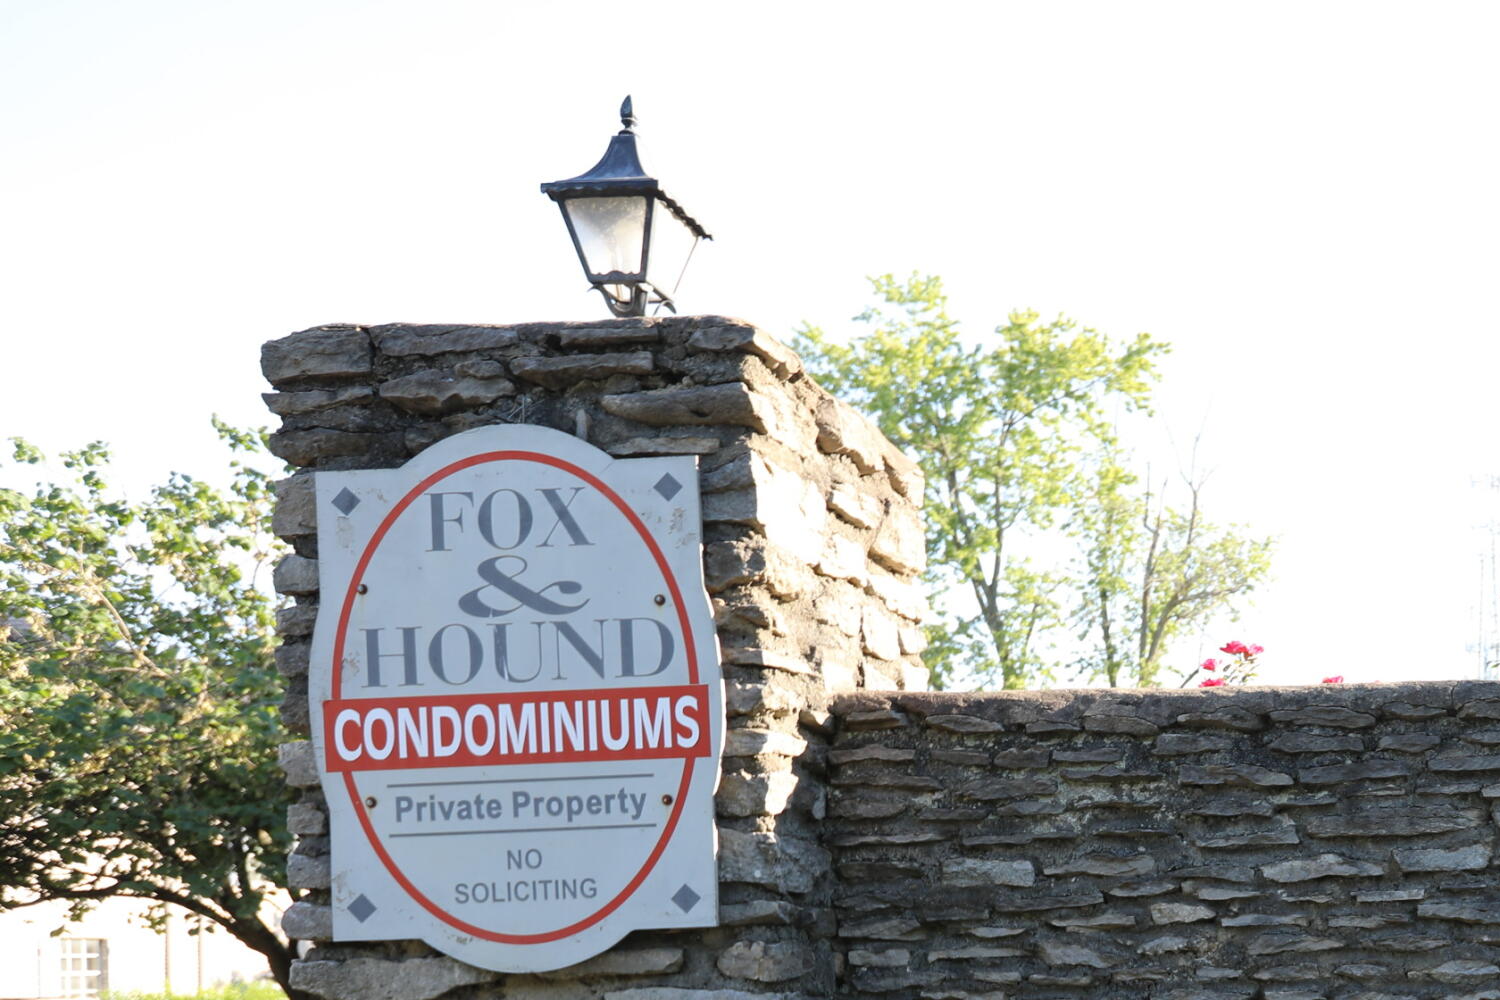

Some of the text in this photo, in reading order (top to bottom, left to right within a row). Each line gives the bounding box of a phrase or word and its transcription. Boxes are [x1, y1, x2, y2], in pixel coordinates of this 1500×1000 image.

[424, 486, 595, 552] FOX
[458, 555, 591, 618] &
[360, 617, 675, 688] HOUND
[334, 695, 700, 761] CONDOMINIUMS
[395, 787, 646, 823] Private Property
[454, 877, 598, 905] SOLICITING
[506, 848, 543, 871] NO
